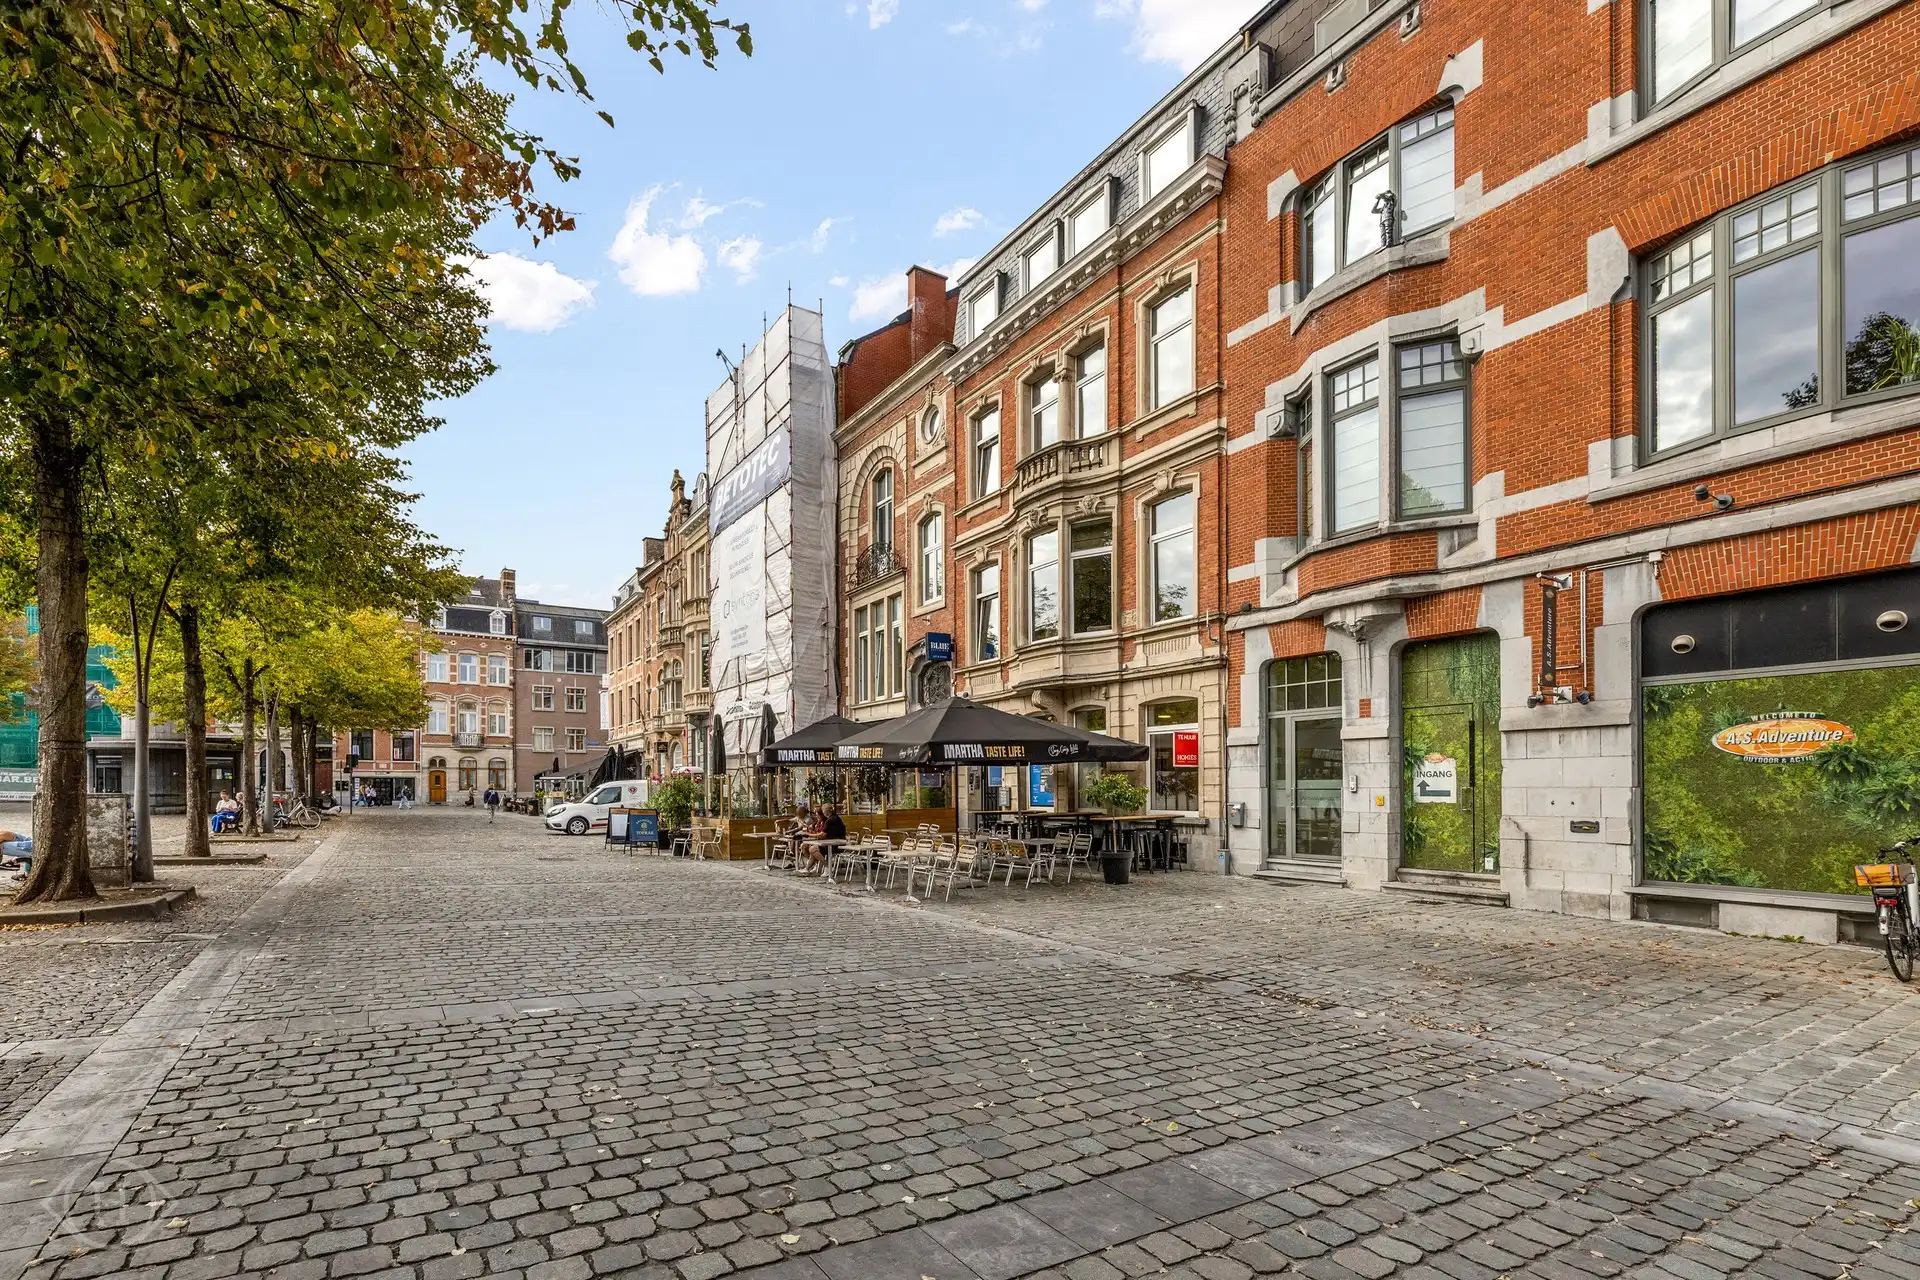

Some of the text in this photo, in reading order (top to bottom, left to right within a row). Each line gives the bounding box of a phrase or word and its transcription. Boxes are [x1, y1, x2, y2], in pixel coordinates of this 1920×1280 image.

[714, 434, 781, 513] BETOTEC
[1751, 711, 1816, 722] WELCOME TO
[1725, 729, 1845, 745] A.S.Adventure
[777, 749, 837, 762] MARTHA TAST
[838, 745, 859, 759] MARTHA
[943, 743, 1026, 759] MARTHA TASTE LIFE!
[1743, 755, 1779, 764] OUTDOOR
[1781, 756, 1787, 764] &
[1416, 770, 1453, 778] INGANG
